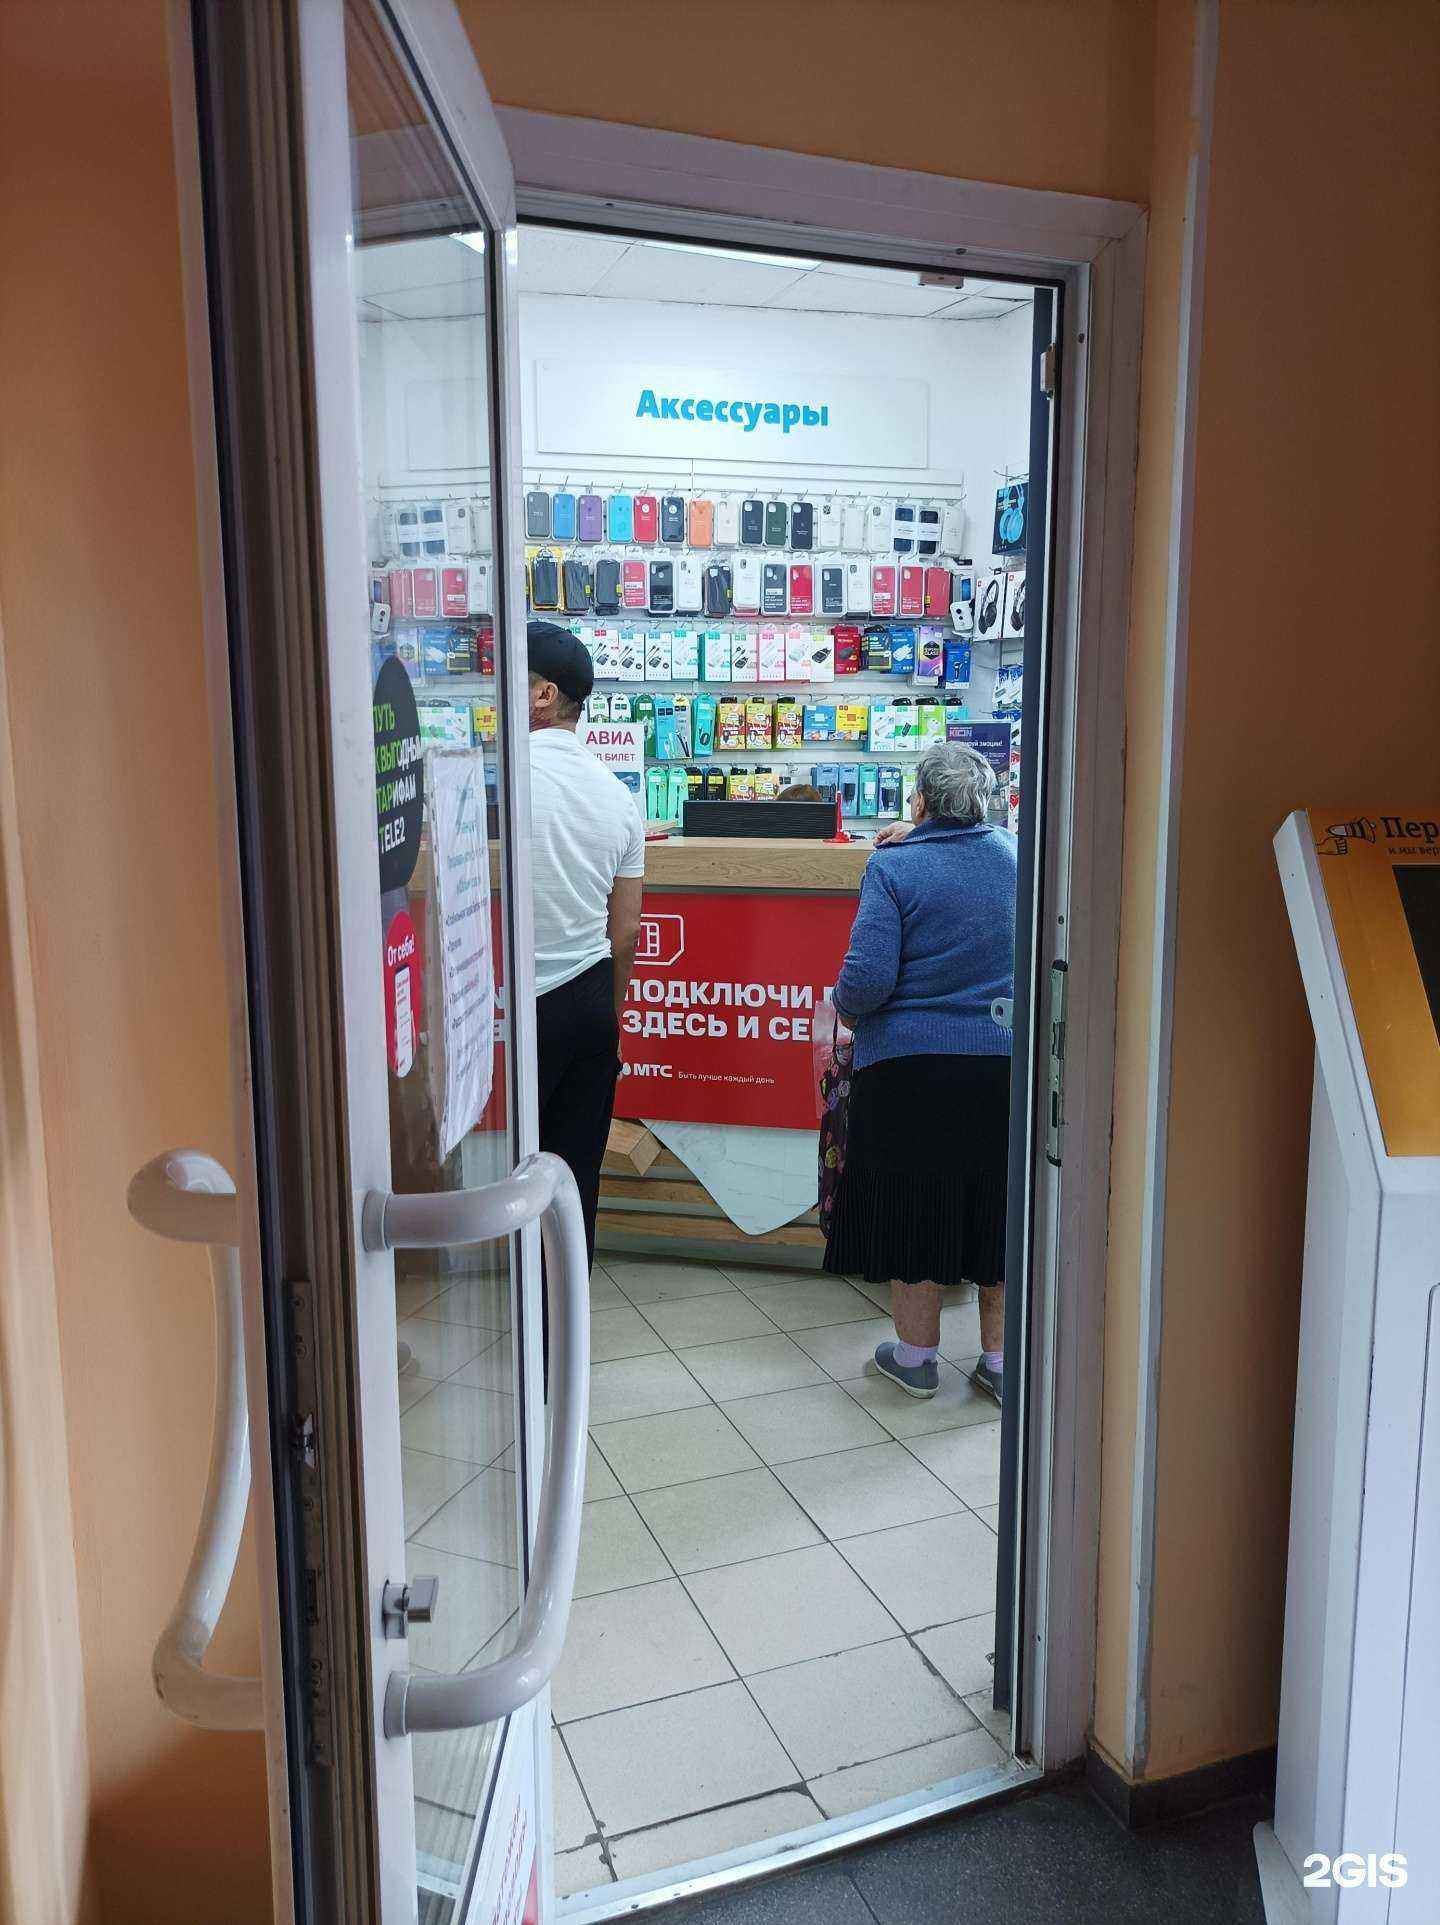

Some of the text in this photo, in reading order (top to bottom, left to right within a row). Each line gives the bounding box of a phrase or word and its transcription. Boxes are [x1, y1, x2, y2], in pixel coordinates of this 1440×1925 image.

[636, 389, 829, 434] Аксессуары
[586, 730, 635, 745] АВИА
[604, 752, 637, 762] БИЛЕТ
[376, 773, 416, 814] ТАРИФАМ
[379, 816, 406, 854] TELE2
[624, 979, 813, 1009] ПОДКЛЮЧИ
[622, 1009, 815, 1041] ЗДЕСЬ И СЕ
[633, 1062, 673, 1078] МТС
[678, 1071, 775, 1085] Быть лучше каждый день
